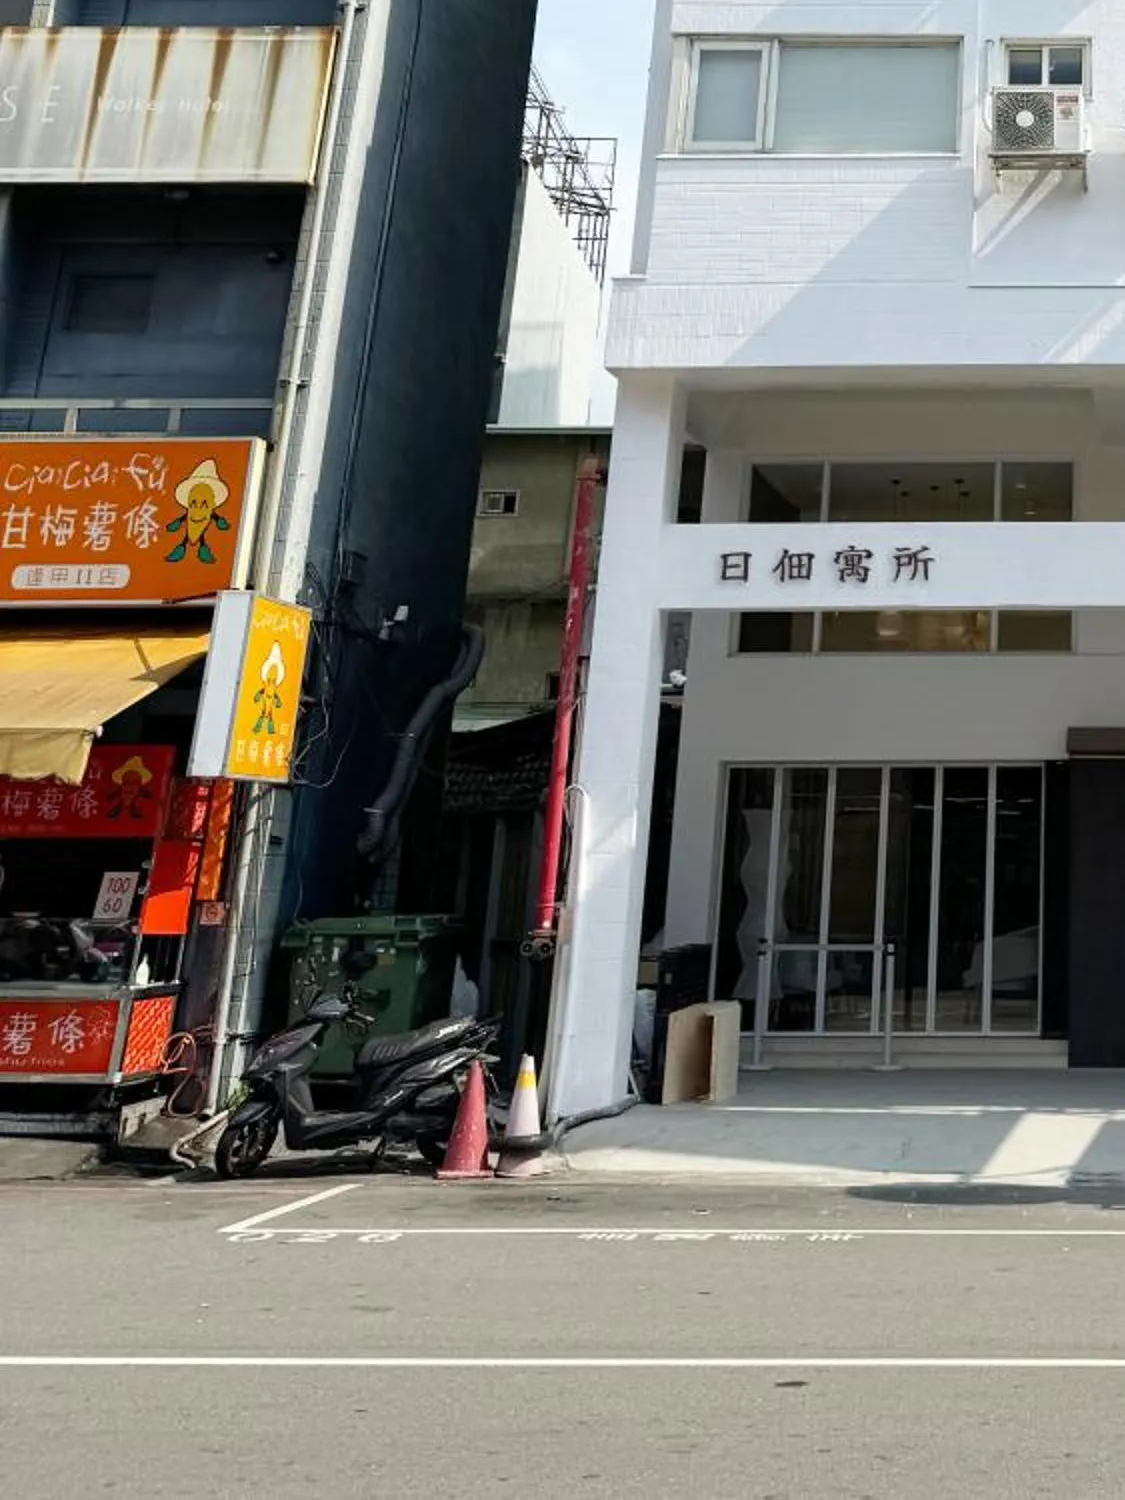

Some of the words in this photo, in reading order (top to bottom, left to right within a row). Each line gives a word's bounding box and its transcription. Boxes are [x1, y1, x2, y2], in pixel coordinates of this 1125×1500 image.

[1, 497, 161, 551] 甘梅薯條
[719, 544, 937, 584] 日佃寓所
